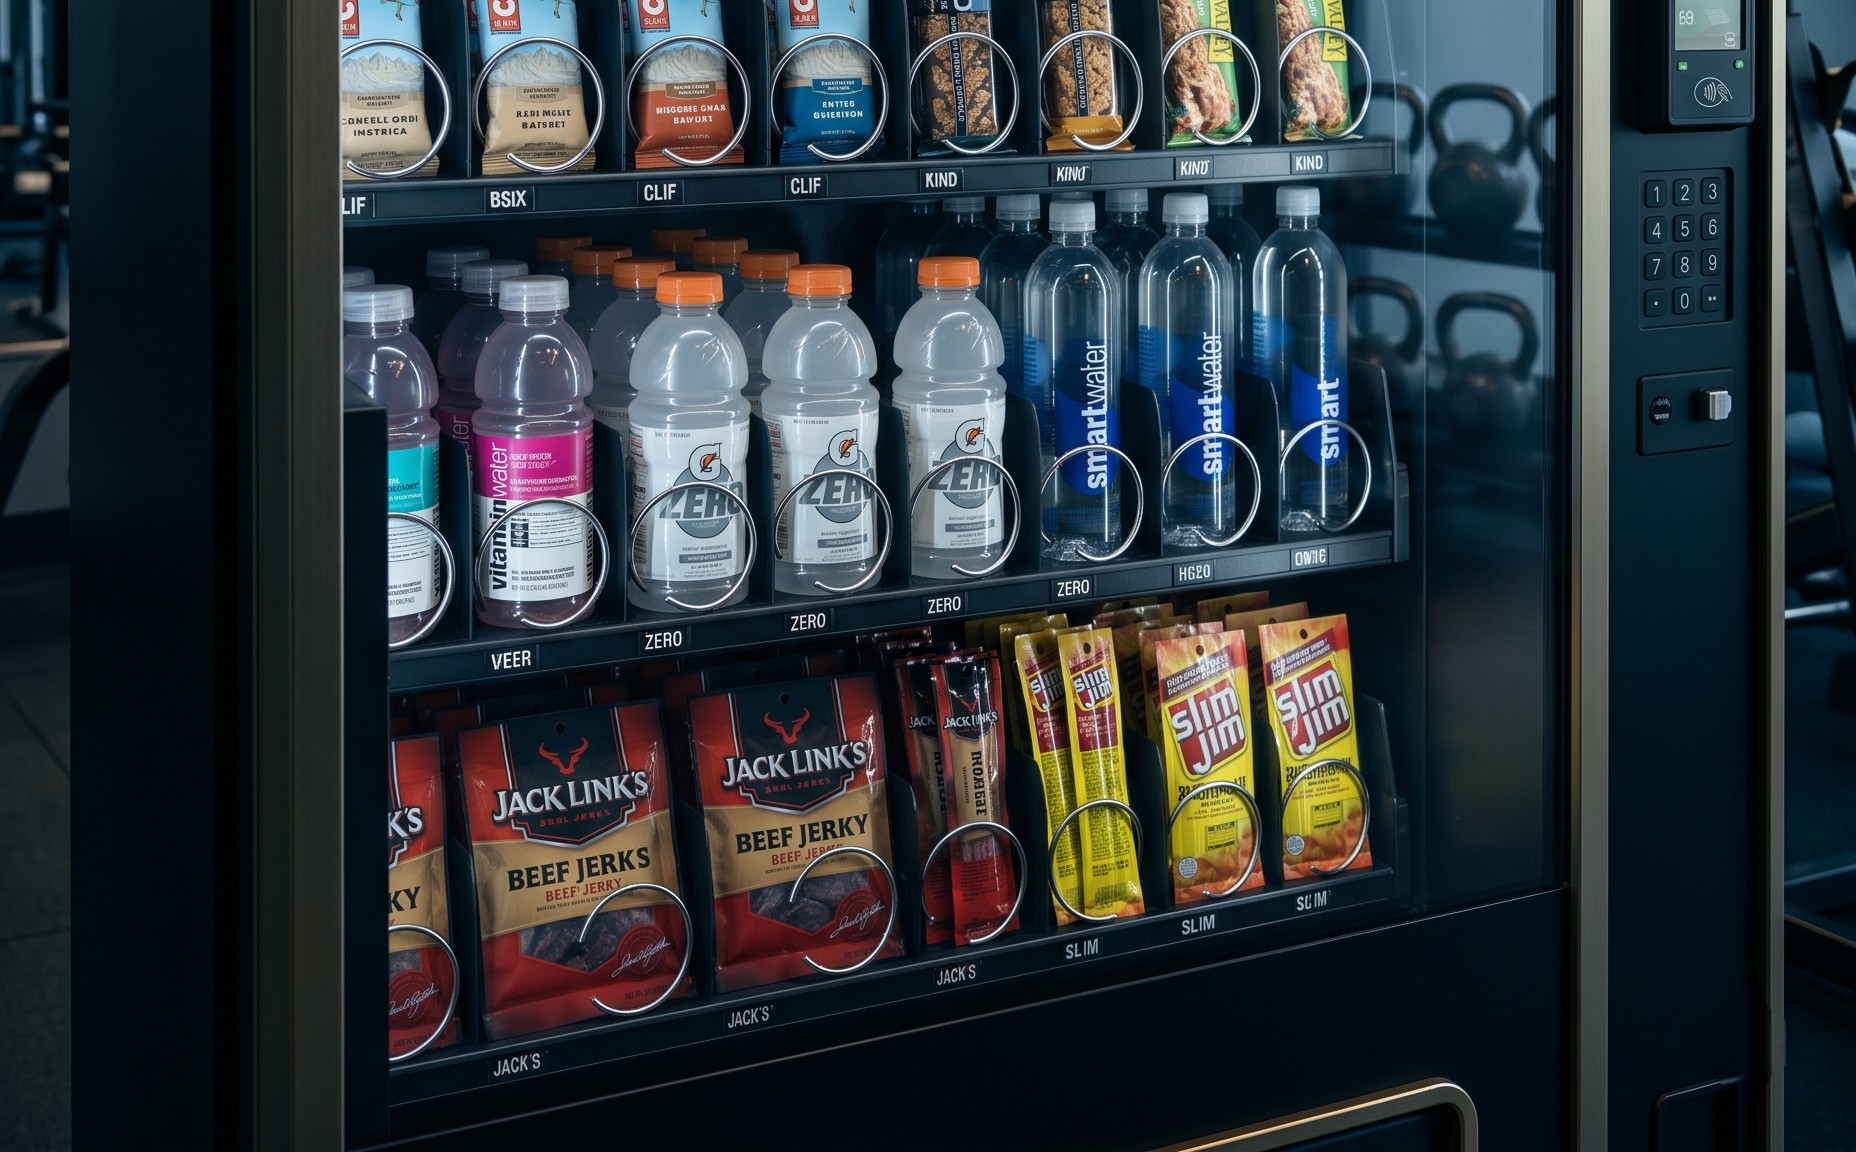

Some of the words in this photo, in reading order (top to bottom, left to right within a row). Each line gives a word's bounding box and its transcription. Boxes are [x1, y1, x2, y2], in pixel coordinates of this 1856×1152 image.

[1296, 155, 1323, 171] KIND
[791, 177, 822, 194] CLIF
[925, 171, 958, 188] KIND
[490, 190, 527, 208] BSIX
[644, 183, 677, 201] CLIF
[1652, 186, 1659, 202] 1
[1681, 184, 1689, 201] 2
[1708, 183, 1717, 200] 3
[1652, 222, 1661, 238] 4
[1681, 220, 1689, 237] 5
[1708, 219, 1717, 235] 6
[1652, 258, 1660, 275] 7
[1680, 256, 1689, 273] 8
[1708, 254, 1717, 271] 9
[1680, 293, 1689, 309] 0
[928, 455, 1002, 491] ZERO
[799, 467, 876, 504] ZERO
[660, 481, 744, 519] ZERO
[1057, 579, 1089, 597] ZERO
[928, 596, 961, 614] ZERO
[791, 613, 826, 632] ZERO
[645, 630, 682, 650] ZERO
[722, 751, 790, 788] JACK
[791, 741, 868, 776] LINK'S
[493, 786, 570, 821] JACK
[569, 771, 649, 808] LINK'S
[735, 825, 793, 855] BEEF
[799, 813, 869, 844] JERKY
[771, 850, 801, 865] BEEF
[507, 860, 570, 892] BEEF
[576, 847, 651, 885] JERKS
[582, 877, 622, 897] JERRY
[1182, 914, 1215, 935] SLIM
[1066, 938, 1099, 960] SLIM
